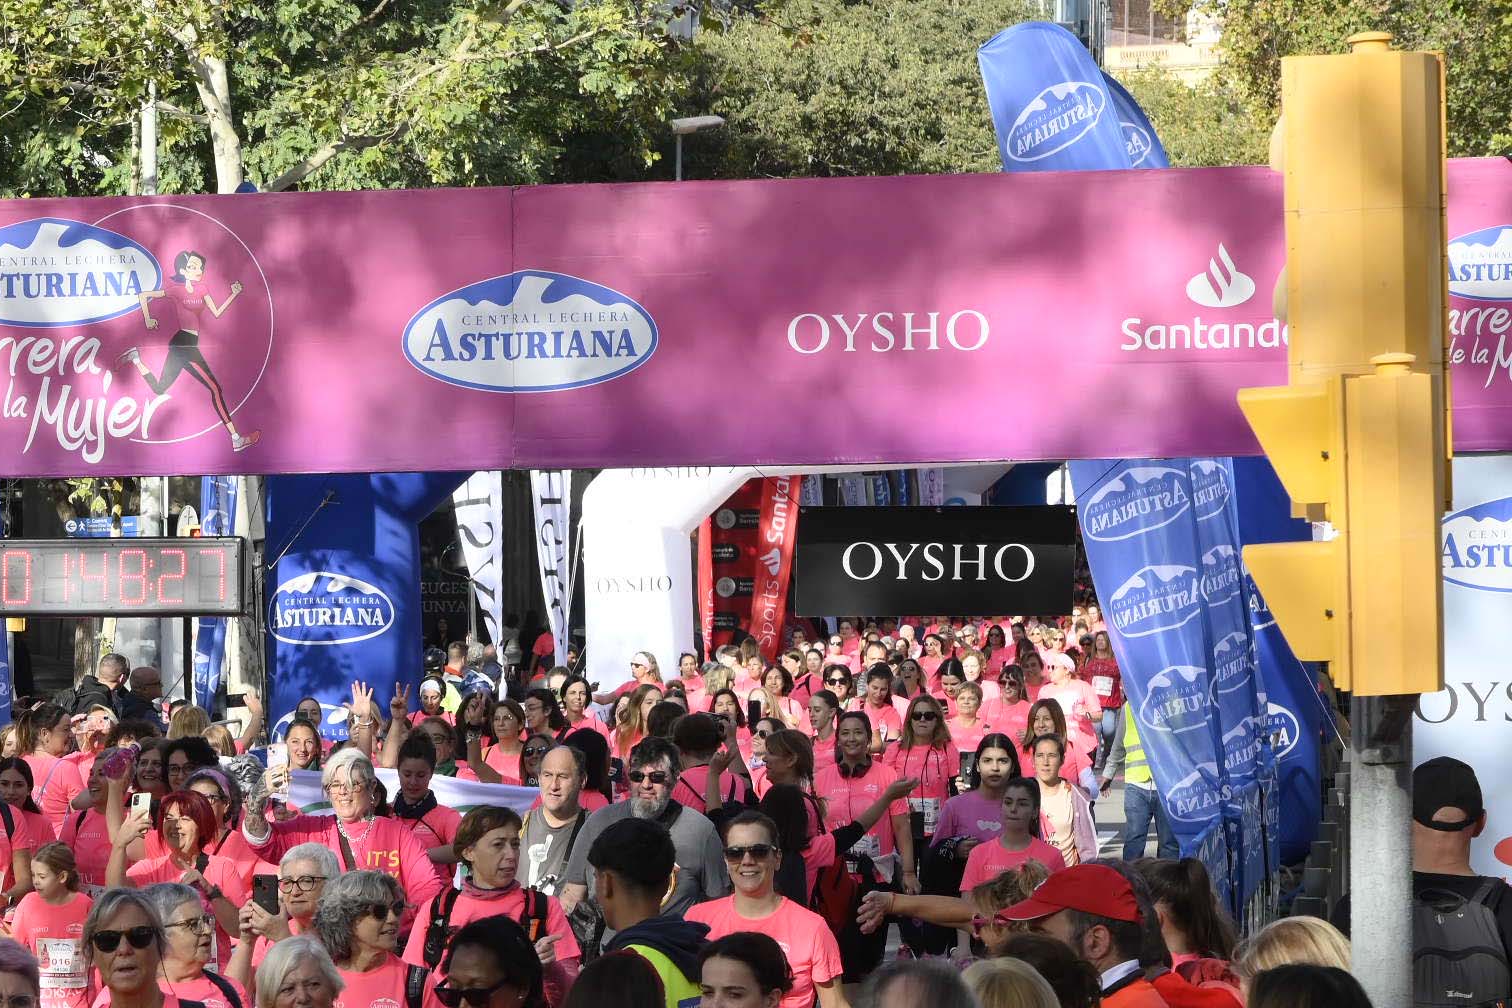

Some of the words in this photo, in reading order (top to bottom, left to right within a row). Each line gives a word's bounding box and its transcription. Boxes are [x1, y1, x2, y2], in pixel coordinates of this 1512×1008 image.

[65, 252, 136, 267] LECHERA
[461, 312, 540, 327] CENTRAL
[548, 311, 630, 325] LECHERA
[787, 309, 989, 355] OYSHO
[1121, 316, 1289, 351] Santand
[423, 318, 638, 362] ASTURIANA
[1471, 336, 1489, 364] la
[3, 380, 29, 420] la
[23, 371, 172, 464] Mujer
[842, 542, 1035, 582] OYSHO
[273, 602, 385, 628] ASTURIANA
[284, 597, 327, 606] CENTRAL
[331, 596, 380, 605] LECHERA
[760, 580, 778, 648] Sports
[366, 850, 400, 867] IT'S
